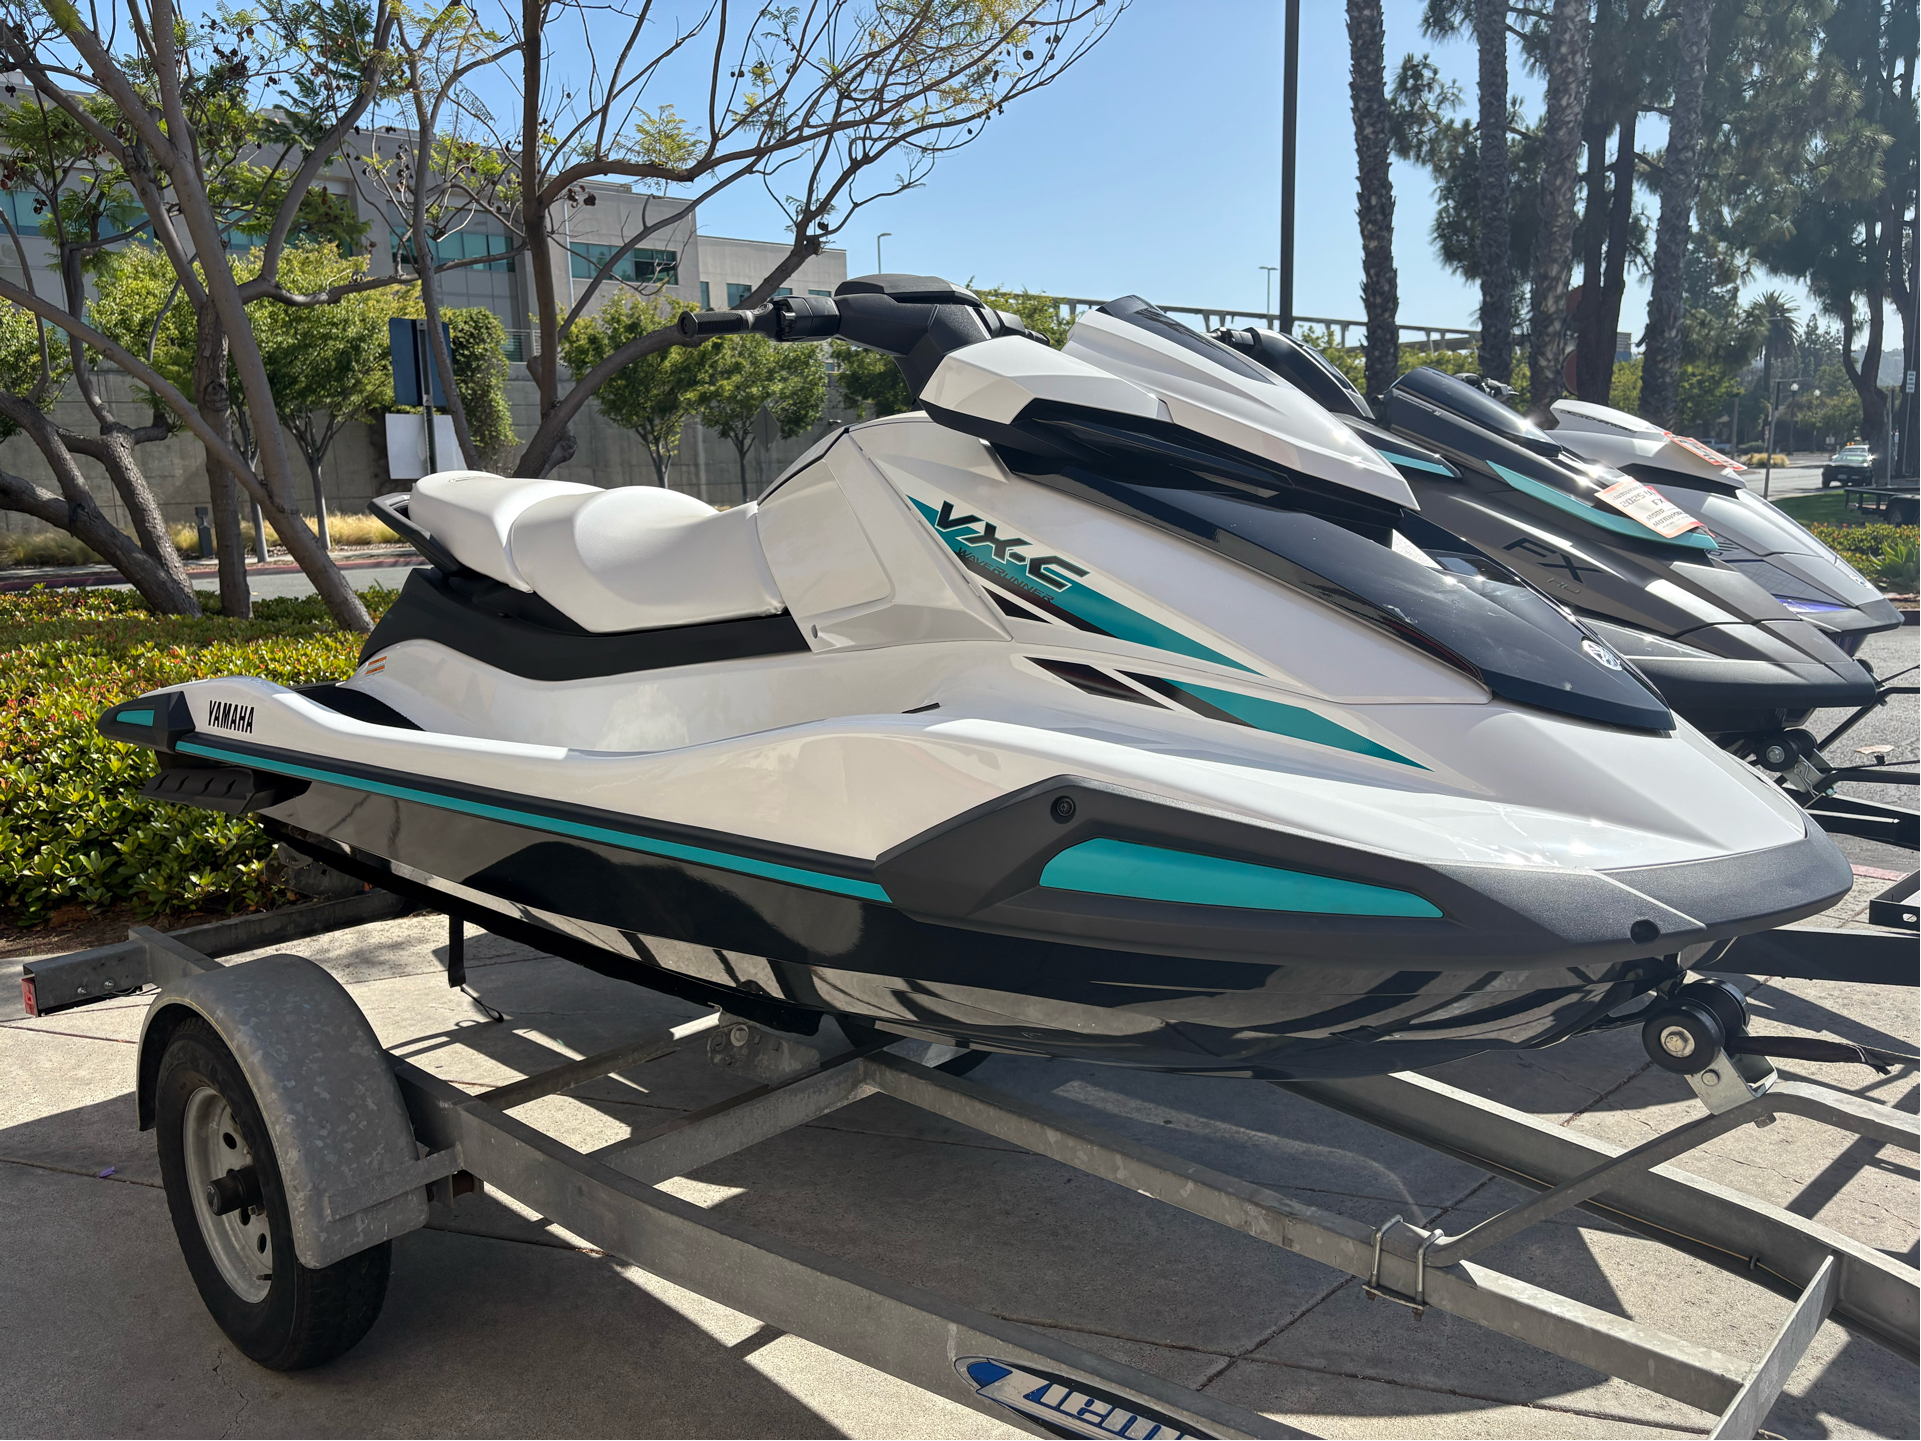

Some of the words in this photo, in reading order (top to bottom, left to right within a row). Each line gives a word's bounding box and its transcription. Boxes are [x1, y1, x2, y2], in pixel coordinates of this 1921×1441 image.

[935, 500, 1091, 593] VX-C
[1502, 537, 1604, 584] FX
[208, 699, 255, 734] YAMAHA
